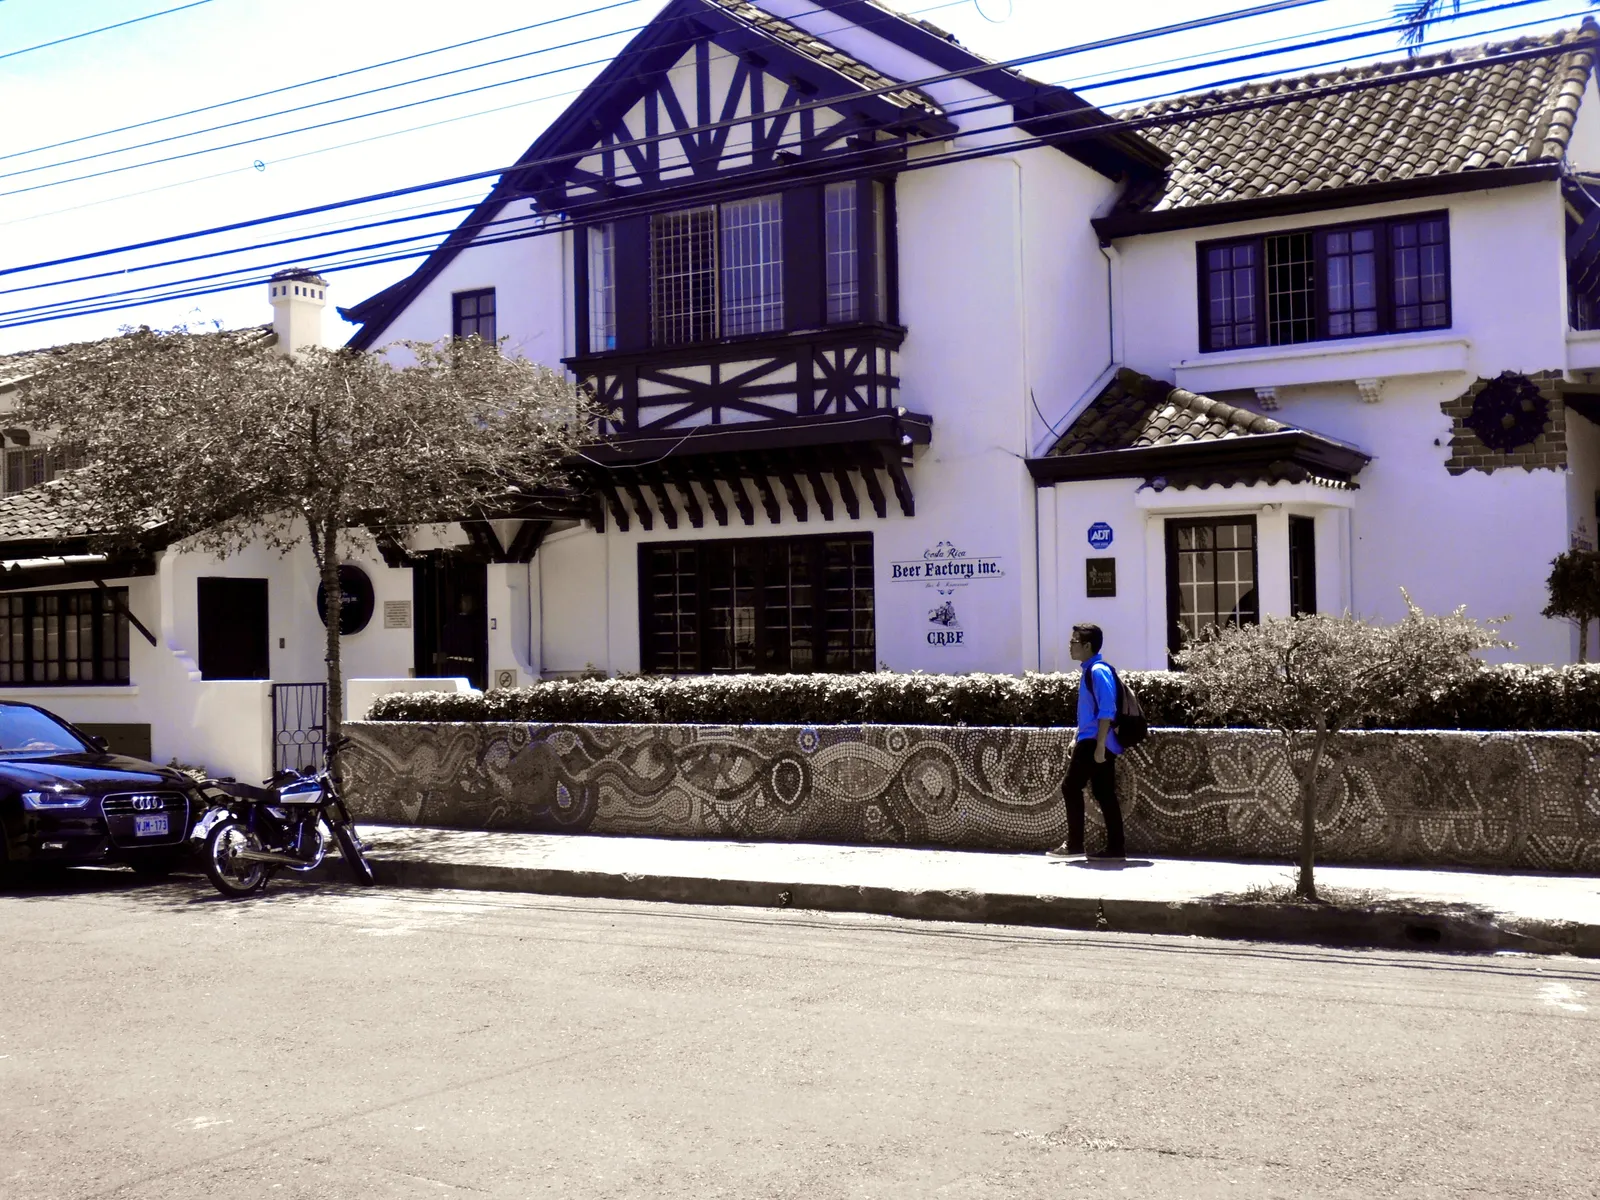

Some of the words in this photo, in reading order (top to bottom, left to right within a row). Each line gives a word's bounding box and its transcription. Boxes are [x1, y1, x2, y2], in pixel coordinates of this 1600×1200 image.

[1091, 529, 1110, 541] ADT
[923, 549, 944, 559] Costa
[946, 548, 966, 558] Rica
[892, 564, 921, 579] Beer
[924, 560, 974, 579] Factory
[978, 559, 1001, 574] inc.
[137, 820, 167, 832] VJM-173
